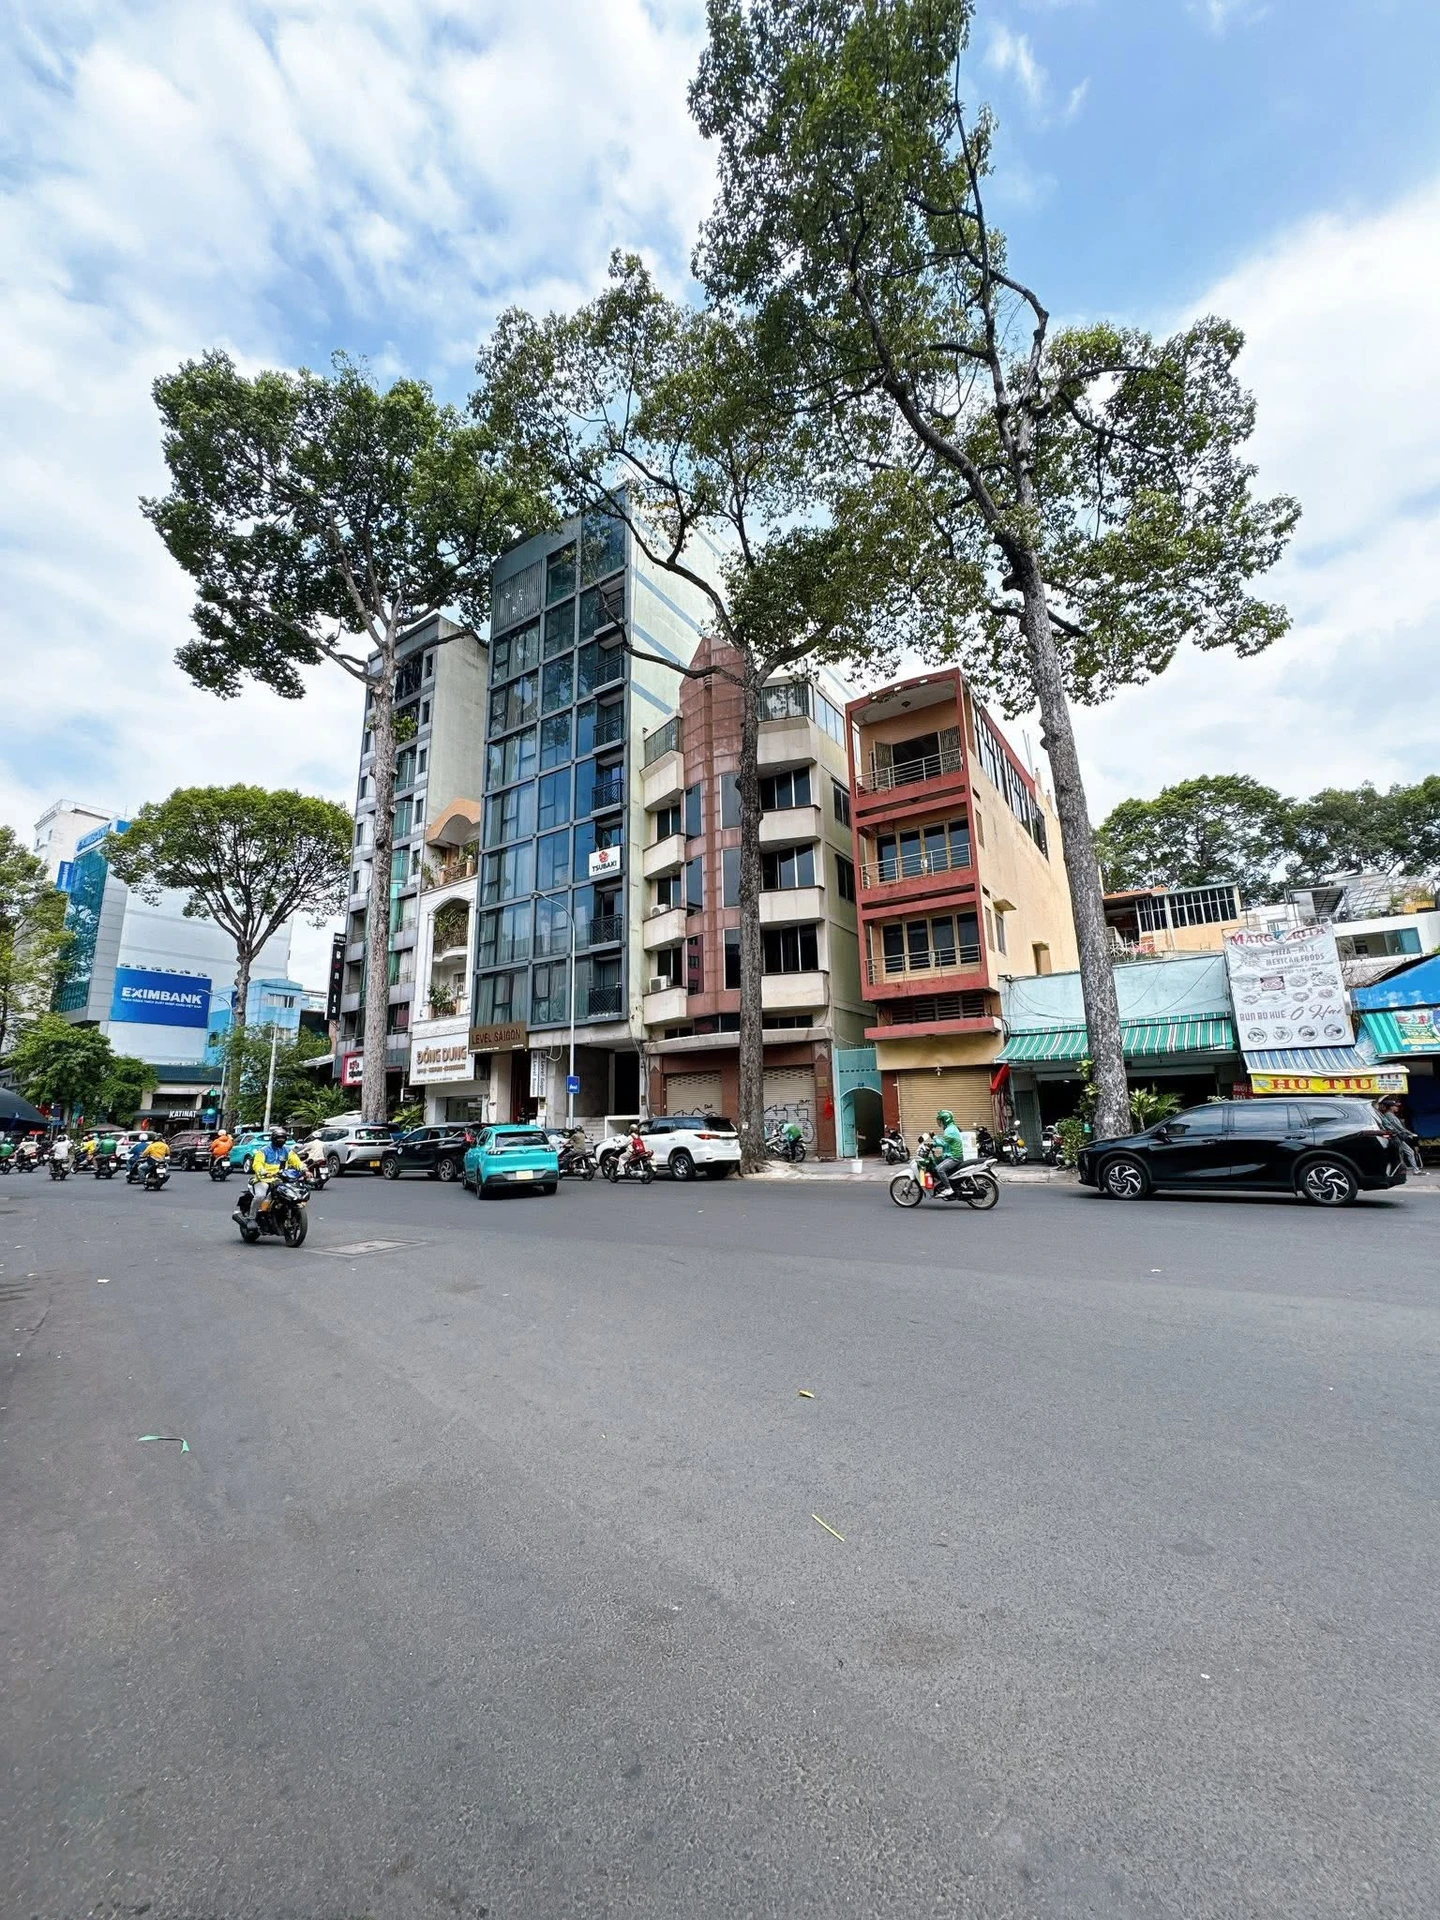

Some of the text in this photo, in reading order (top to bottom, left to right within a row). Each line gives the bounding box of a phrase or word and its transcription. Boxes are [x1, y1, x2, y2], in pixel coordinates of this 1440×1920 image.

[592, 861, 617, 872] TSUBAKI
[121, 987, 202, 1005] EXIMBANK
[472, 1029, 521, 1045] LEVEL SAIGON
[169, 1110, 197, 1118] KATINAT
